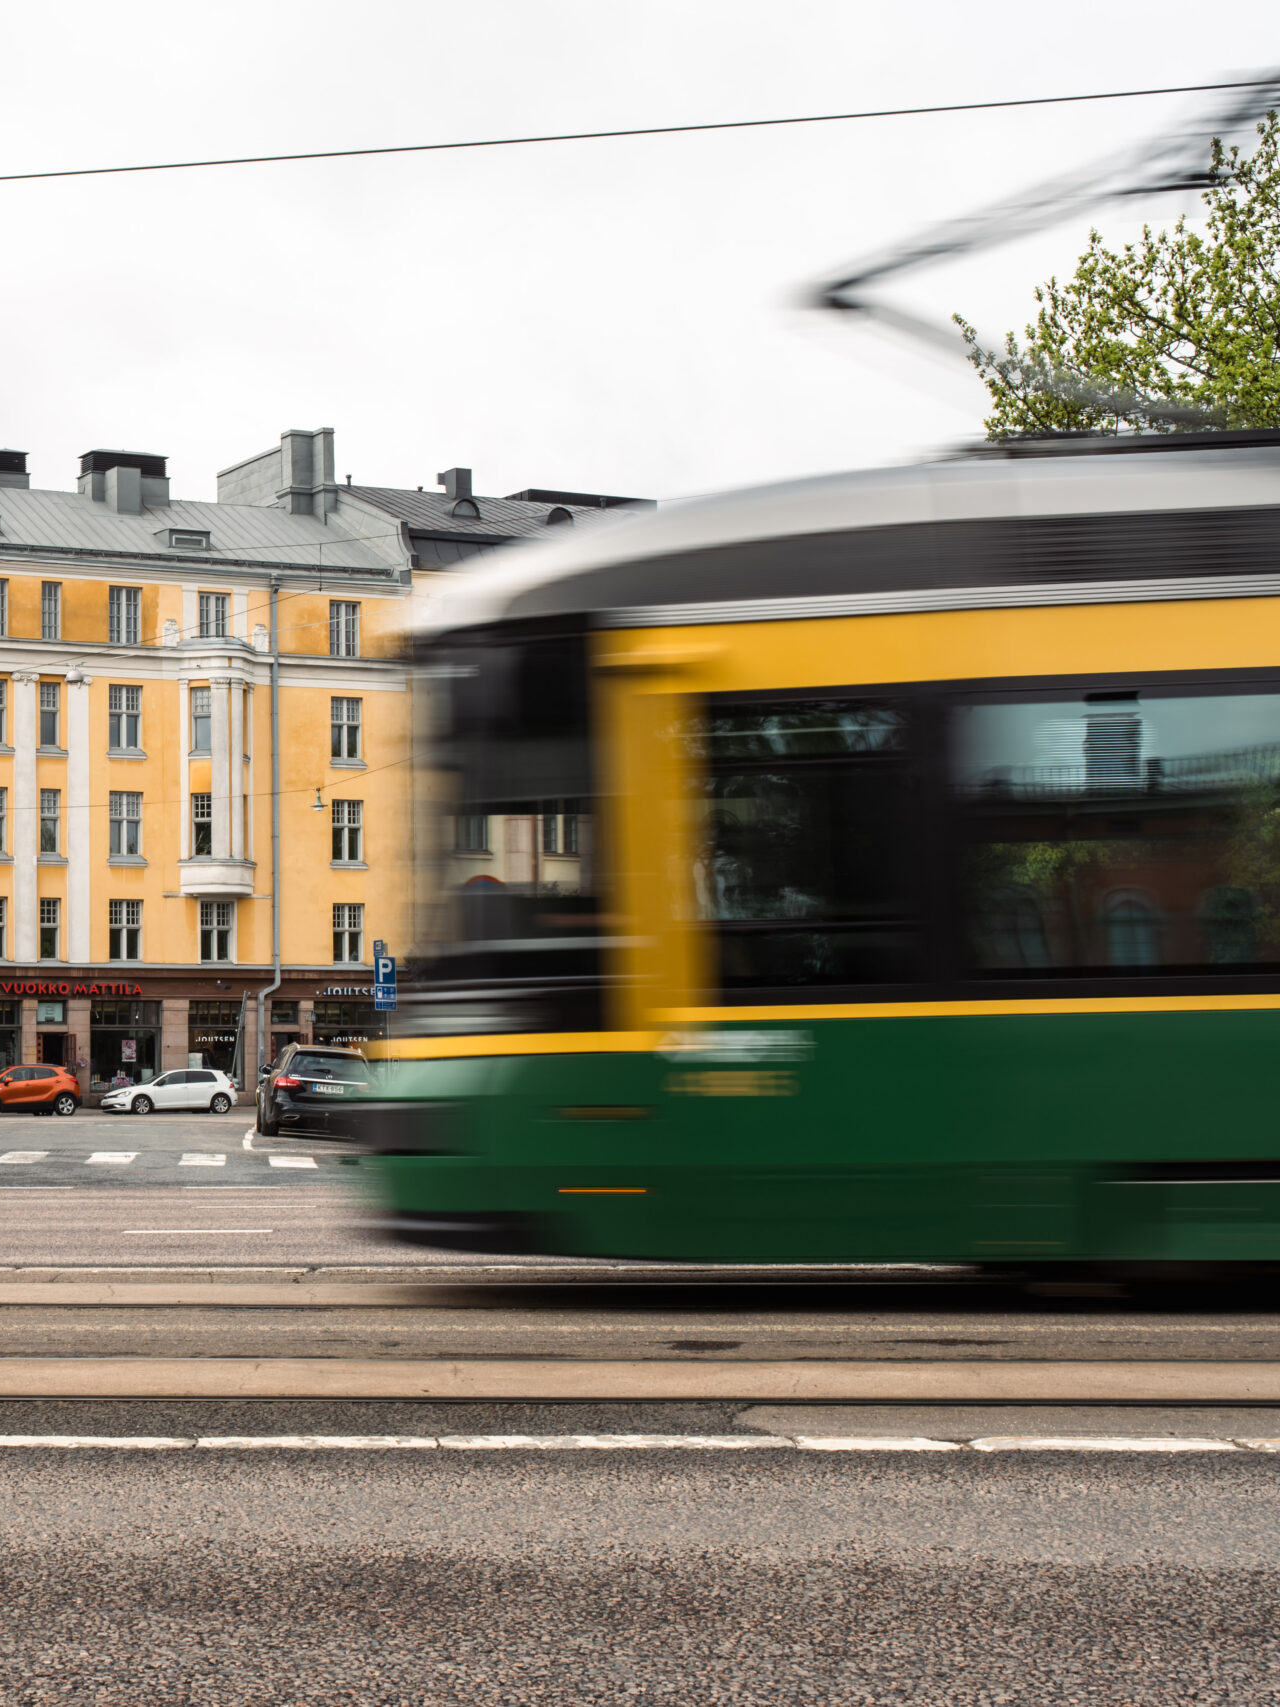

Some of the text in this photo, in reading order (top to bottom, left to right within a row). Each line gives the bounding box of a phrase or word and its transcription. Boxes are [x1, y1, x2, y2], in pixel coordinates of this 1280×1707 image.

[378, 958, 393, 983] P
[2, 982, 144, 995] VUOKKO MATTILA
[322, 986, 375, 996] JOUTSE
